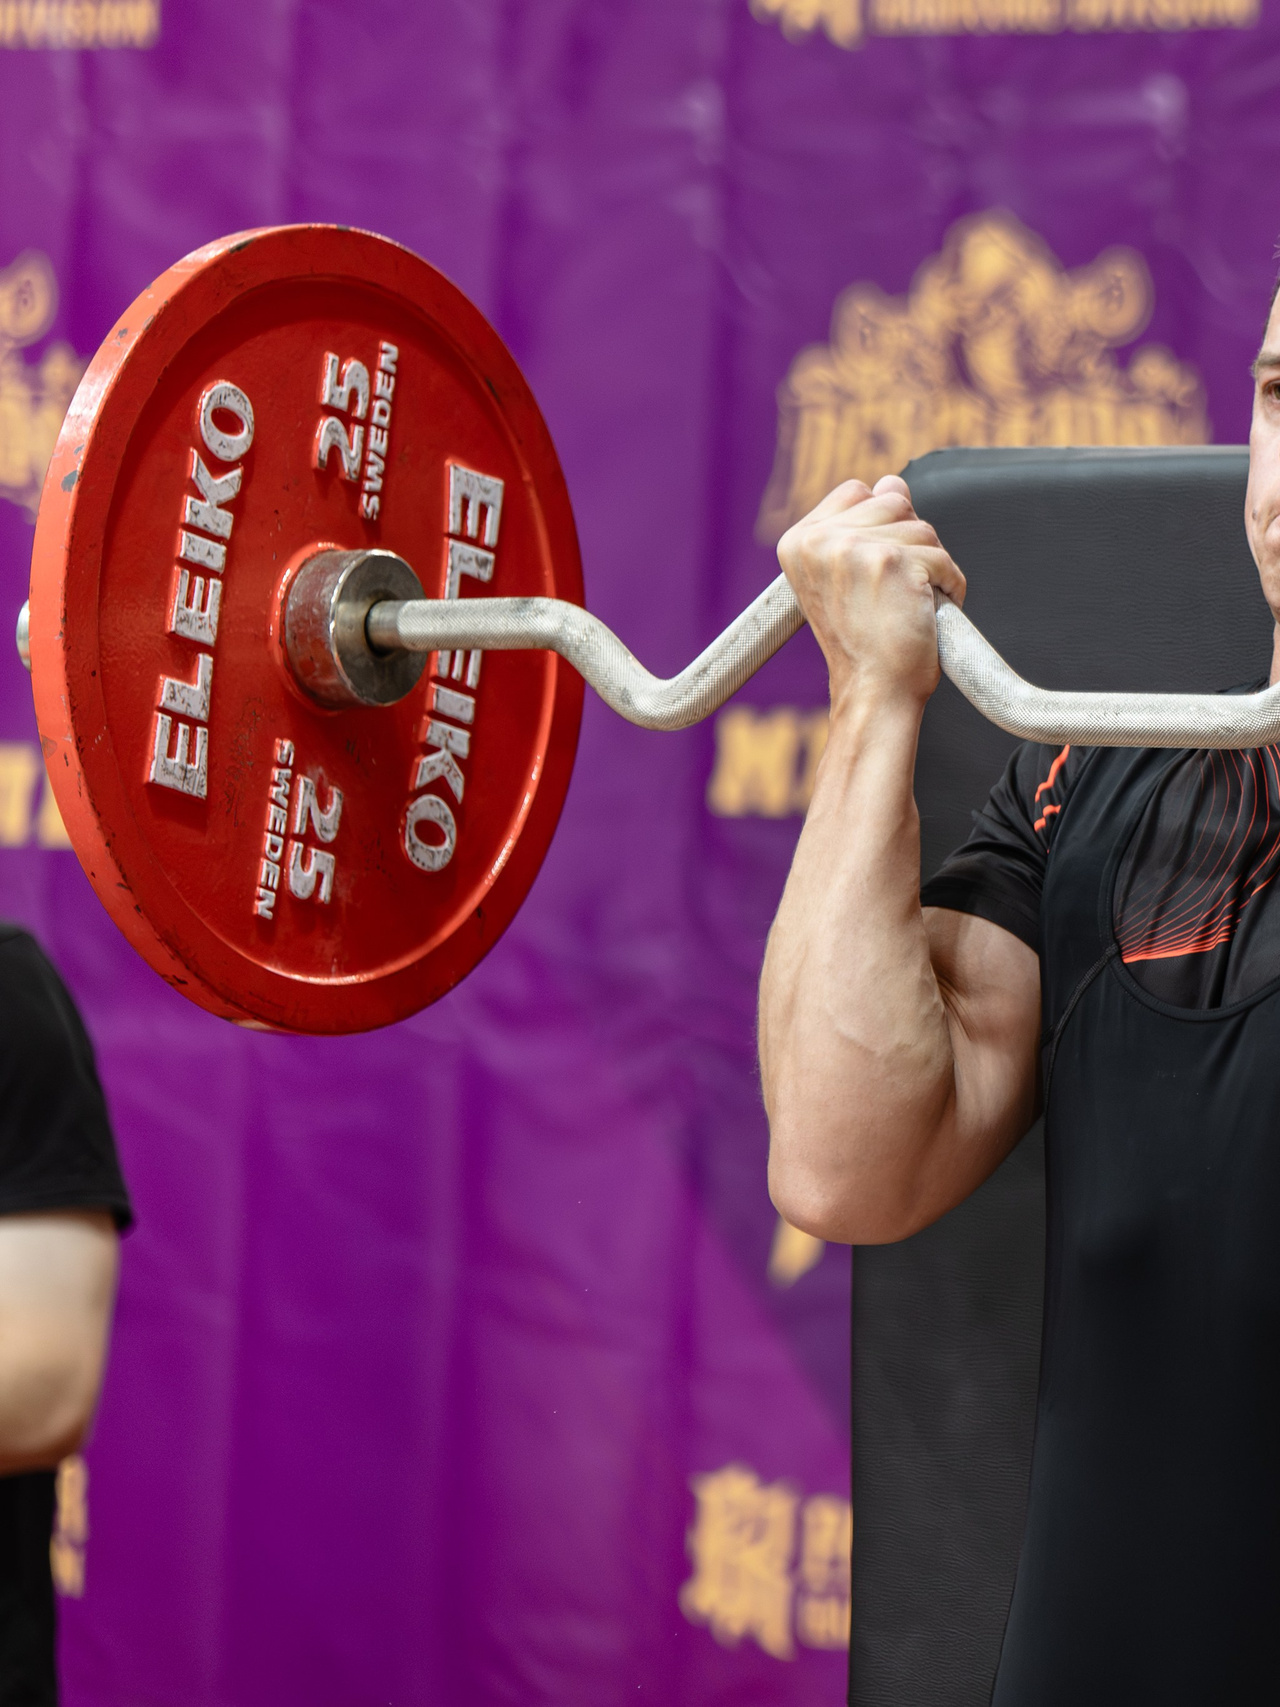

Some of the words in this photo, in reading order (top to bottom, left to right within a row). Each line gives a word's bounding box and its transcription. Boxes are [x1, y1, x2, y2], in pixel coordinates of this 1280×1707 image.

[314, 352, 369, 482] 25
[359, 340, 398, 520] SWEDEN
[147, 380, 254, 799] ELEIKO
[254, 738, 294, 920] SWEDEN
[286, 775, 343, 904] 25
